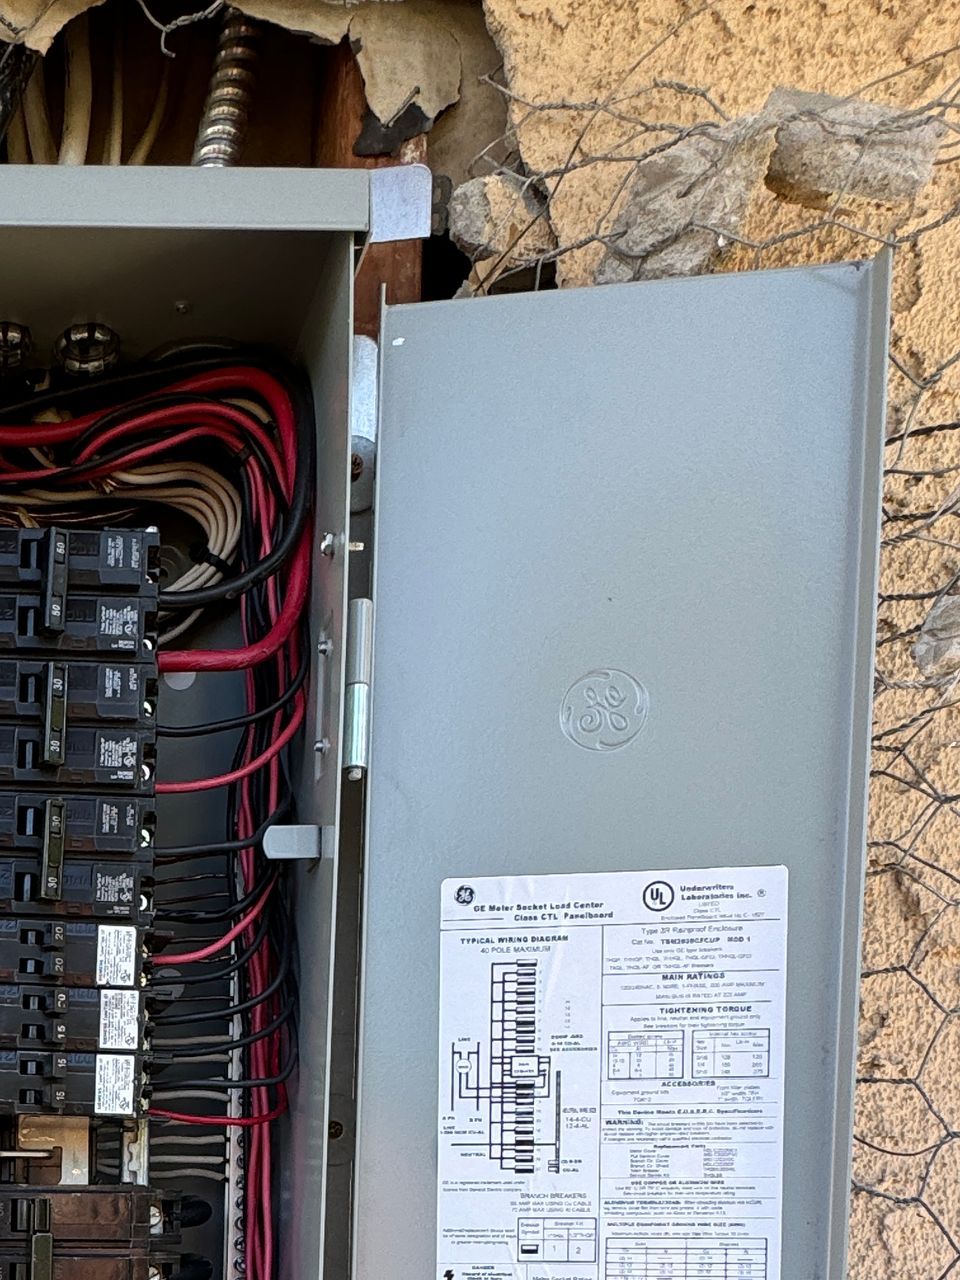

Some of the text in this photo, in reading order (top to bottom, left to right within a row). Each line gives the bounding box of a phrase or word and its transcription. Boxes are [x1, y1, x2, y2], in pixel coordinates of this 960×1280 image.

[53, 678, 63, 691] 30
[50, 740, 60, 752] 30
[52, 816, 61, 827] 30
[48, 877, 57, 888] 30
[550, 902, 571, 910] Load
[541, 913, 558, 921] CTL
[55, 926, 64, 941] 20
[498, 936, 528, 944] WIRING
[55, 957, 64, 972] 20
[687, 972, 725, 980] RATINGS
[717, 1005, 752, 1013] TORQUE
[57, 1025, 66, 1039] 15
[58, 1058, 66, 1068] 15
[56, 1091, 65, 1100] 15
